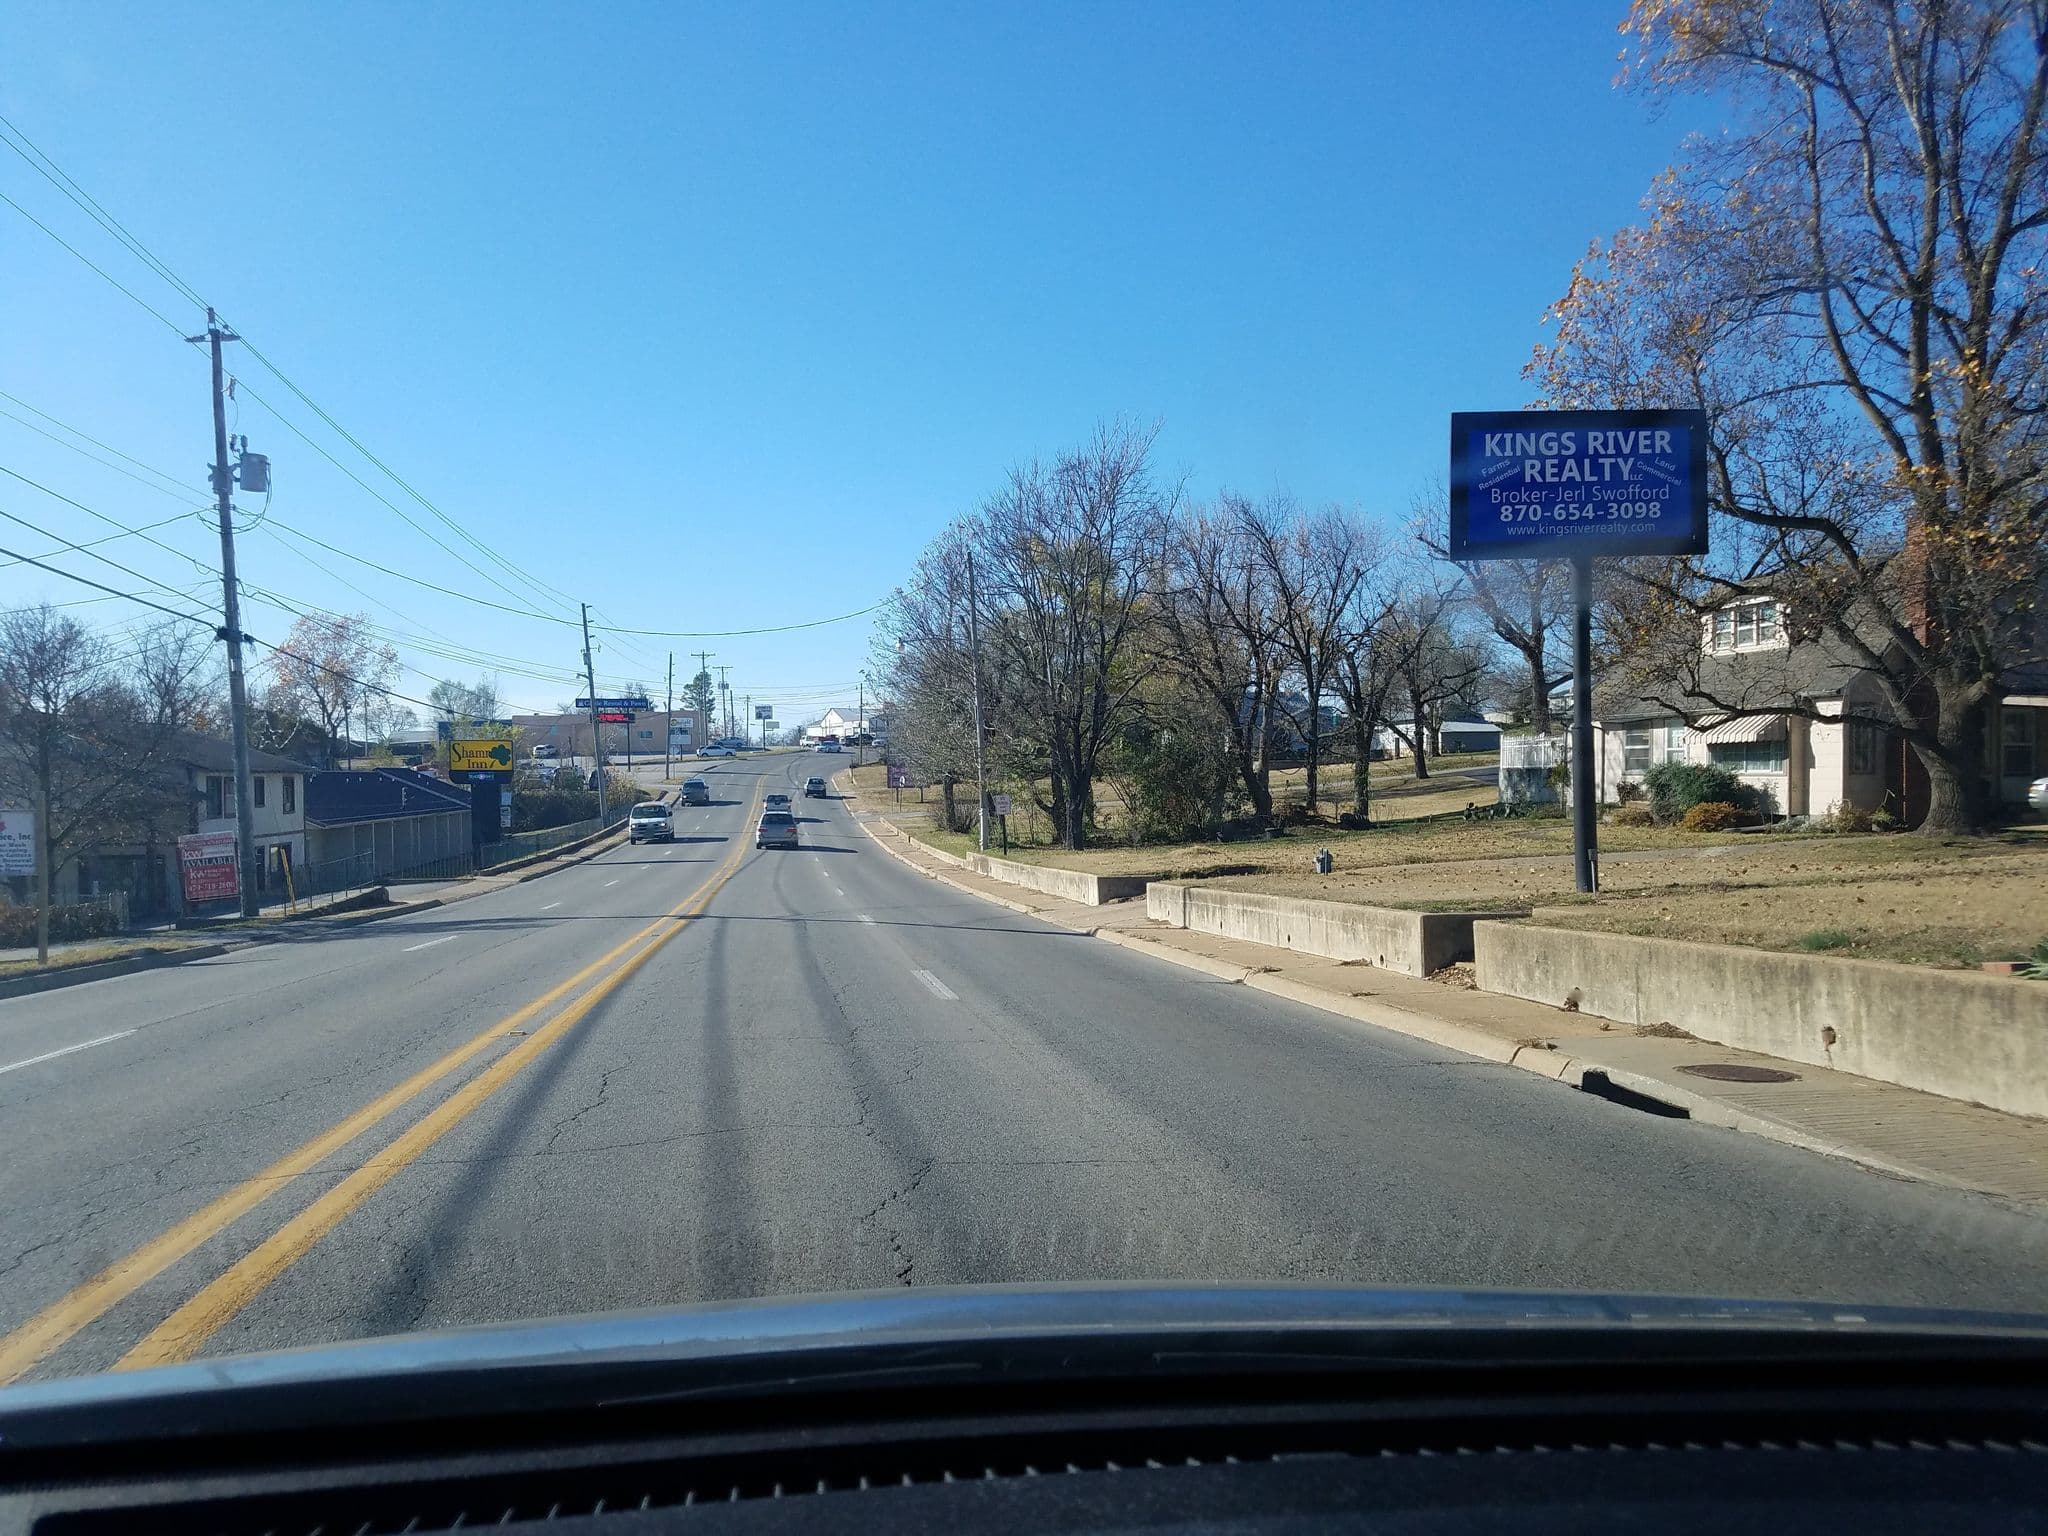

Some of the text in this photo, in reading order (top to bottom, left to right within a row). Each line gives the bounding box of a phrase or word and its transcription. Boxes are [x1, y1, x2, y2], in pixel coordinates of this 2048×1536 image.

[1485, 430, 1672, 456] KINGS RIVER
[1481, 458, 1512, 477] Farms
[1524, 457, 1635, 483] REALTY
[1654, 456, 1676, 471] Land
[1478, 465, 1521, 491] Residential
[1636, 461, 1682, 486] Commercial
[1592, 483, 1670, 501] Swofford
[1500, 501, 1662, 522] 870-654-3098
[1507, 521, 1656, 537] www.kingsriverrealty.com
[467, 759, 488, 769] Inn
[185, 857, 234, 869] AVAILABLE
